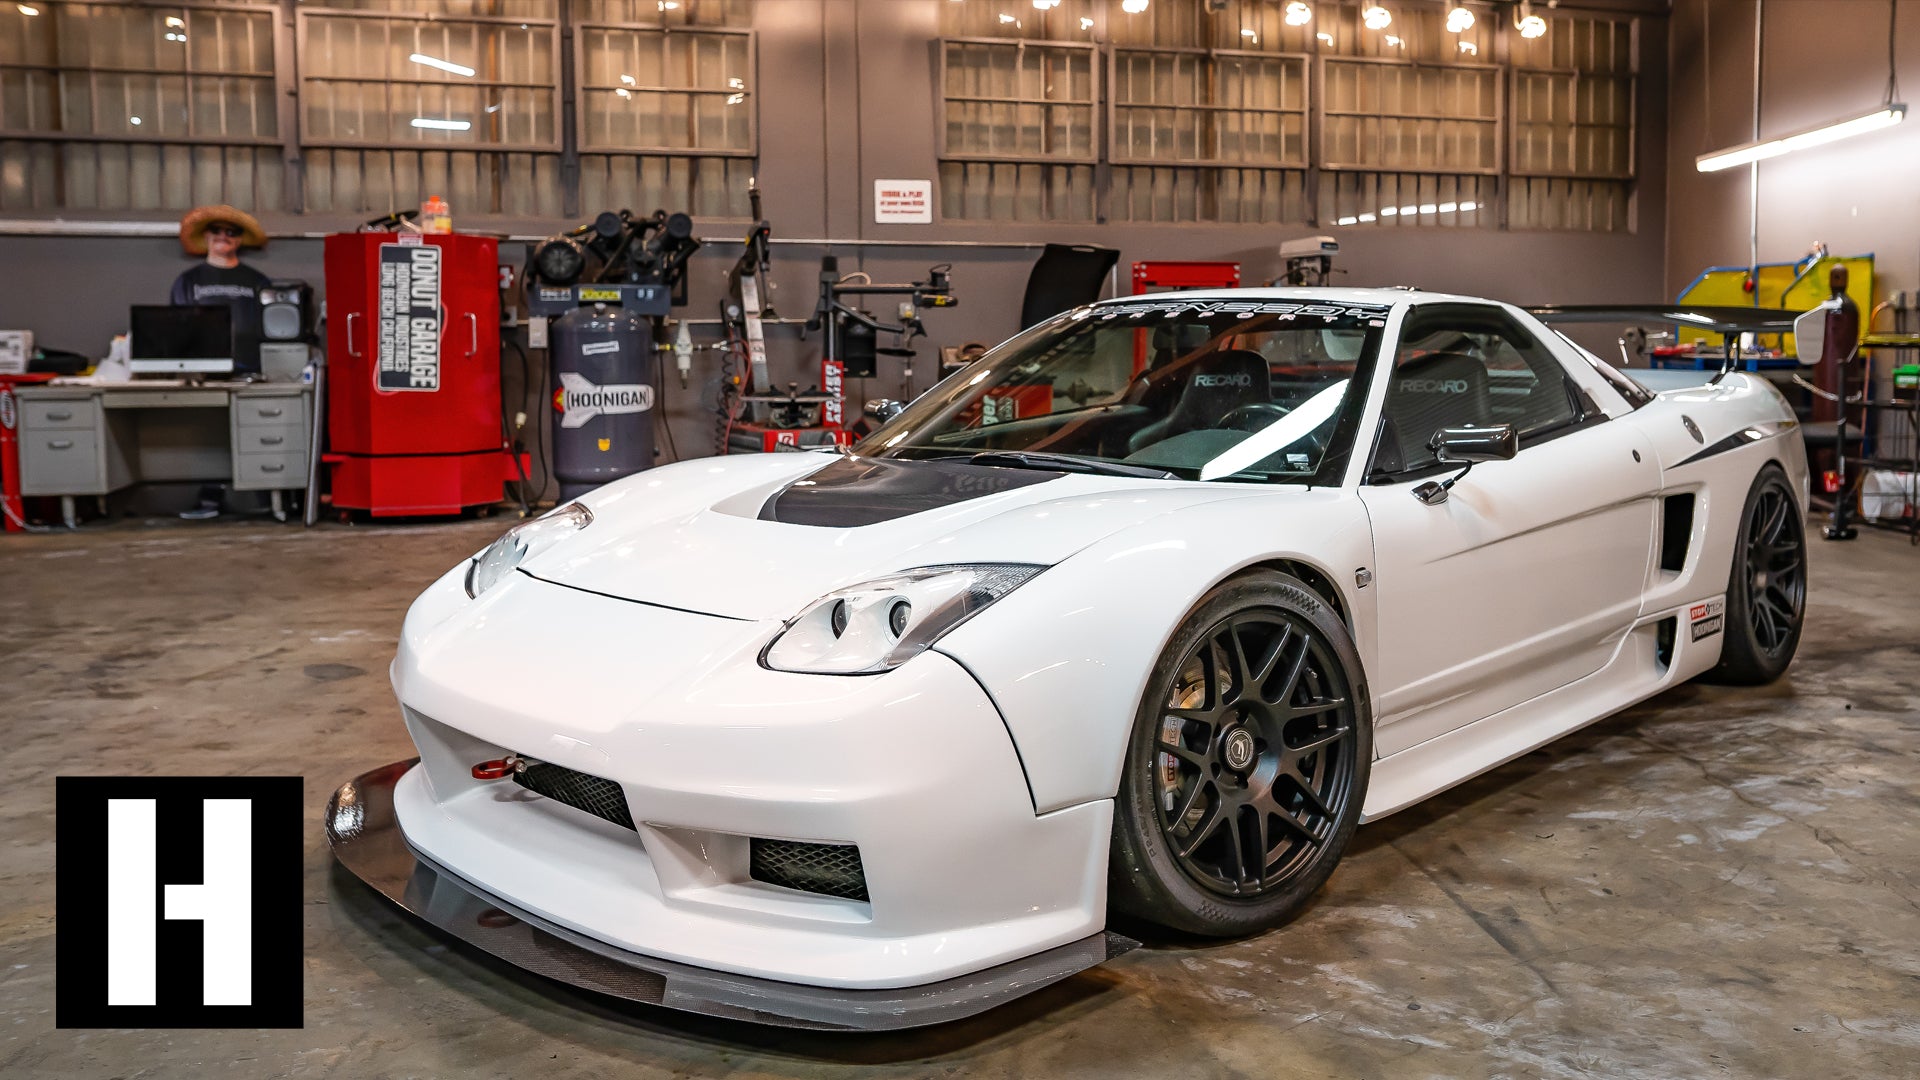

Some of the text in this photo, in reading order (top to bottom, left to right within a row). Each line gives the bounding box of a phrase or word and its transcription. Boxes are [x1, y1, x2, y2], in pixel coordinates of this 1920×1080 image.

[411, 249, 437, 311] DONUT
[381, 262, 395, 372] LONG BEACH CALIFORNIA
[395, 262, 410, 373] HOONIGAN INDUSTRIES
[410, 317, 437, 387] GARAGE
[1194, 374, 1251, 387] RECARO
[1401, 379, 1468, 393] RECARO
[1691, 605, 1706, 619] STOP
